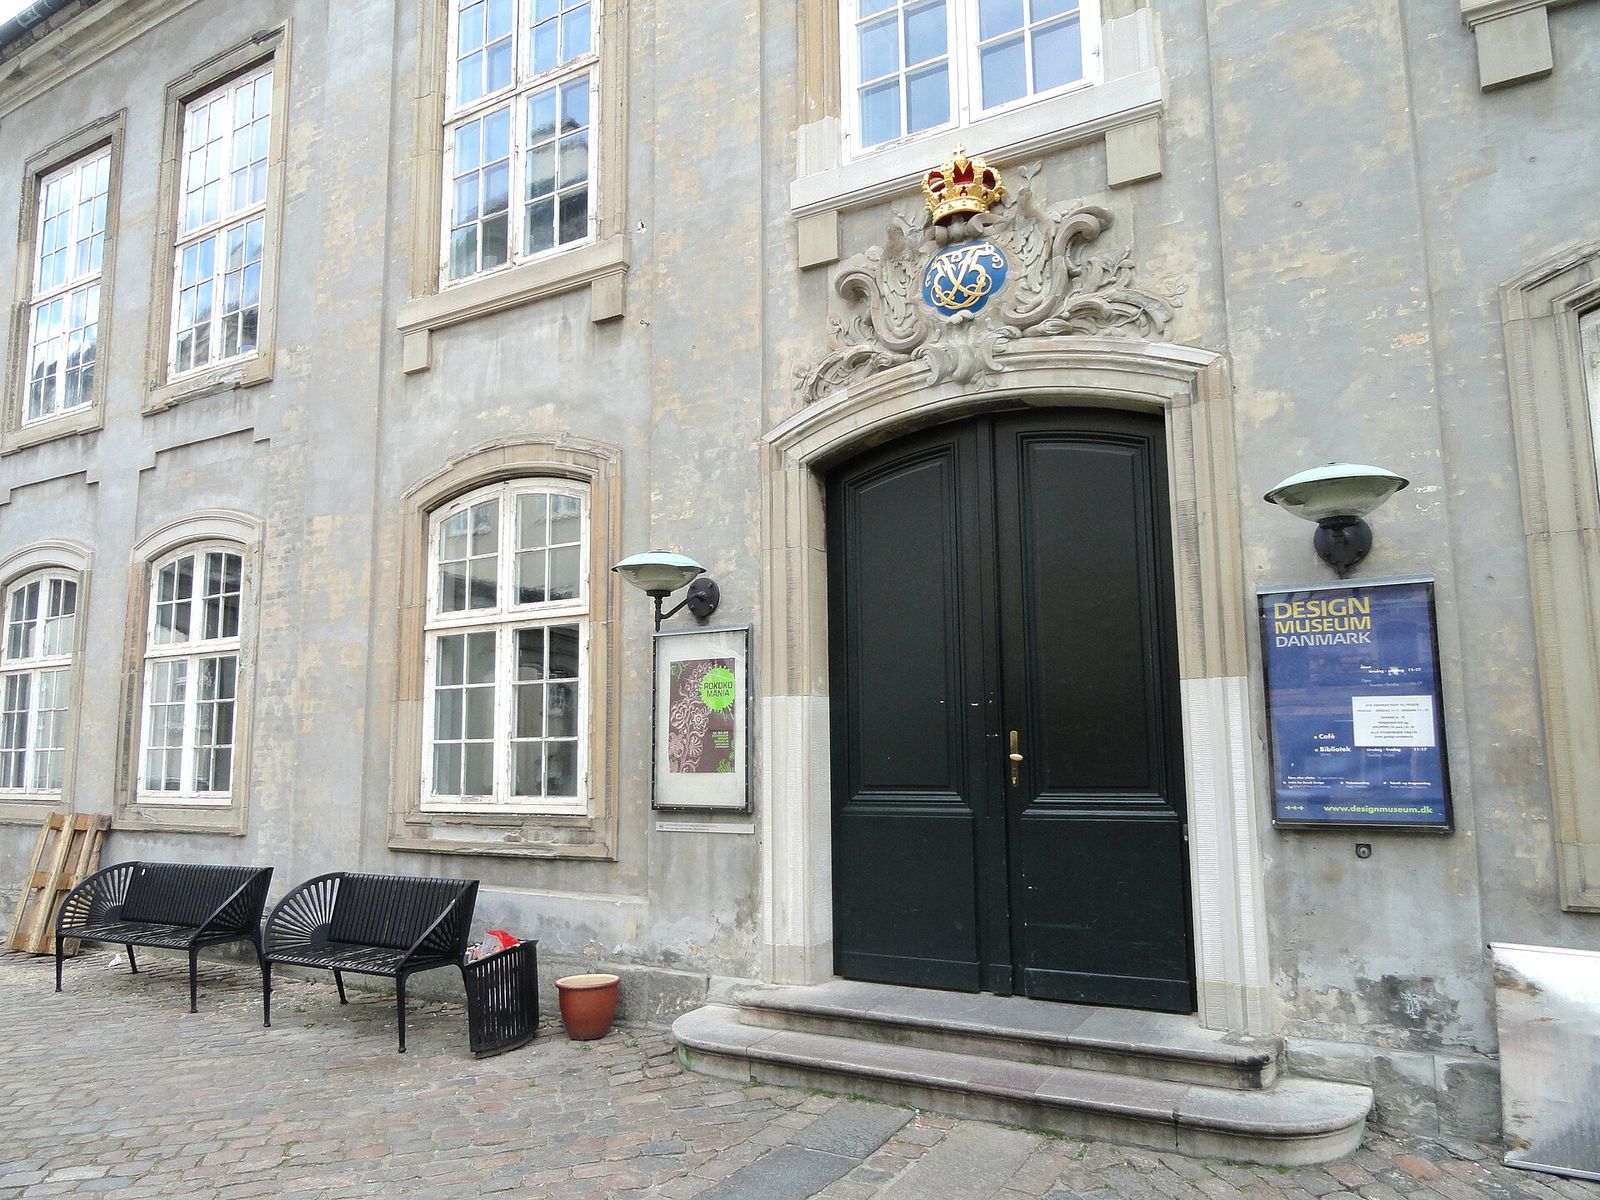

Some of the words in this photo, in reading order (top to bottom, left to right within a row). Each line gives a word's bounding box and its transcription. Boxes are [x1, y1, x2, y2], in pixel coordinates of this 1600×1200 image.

[1274, 596, 1370, 618] DESIGN
[1274, 616, 1371, 634] MUSEUM
[1276, 632, 1372, 648] DANMARK
[704, 682, 732, 690] ROKOKO
[1323, 804, 1433, 814] www.designmuseum.dk
